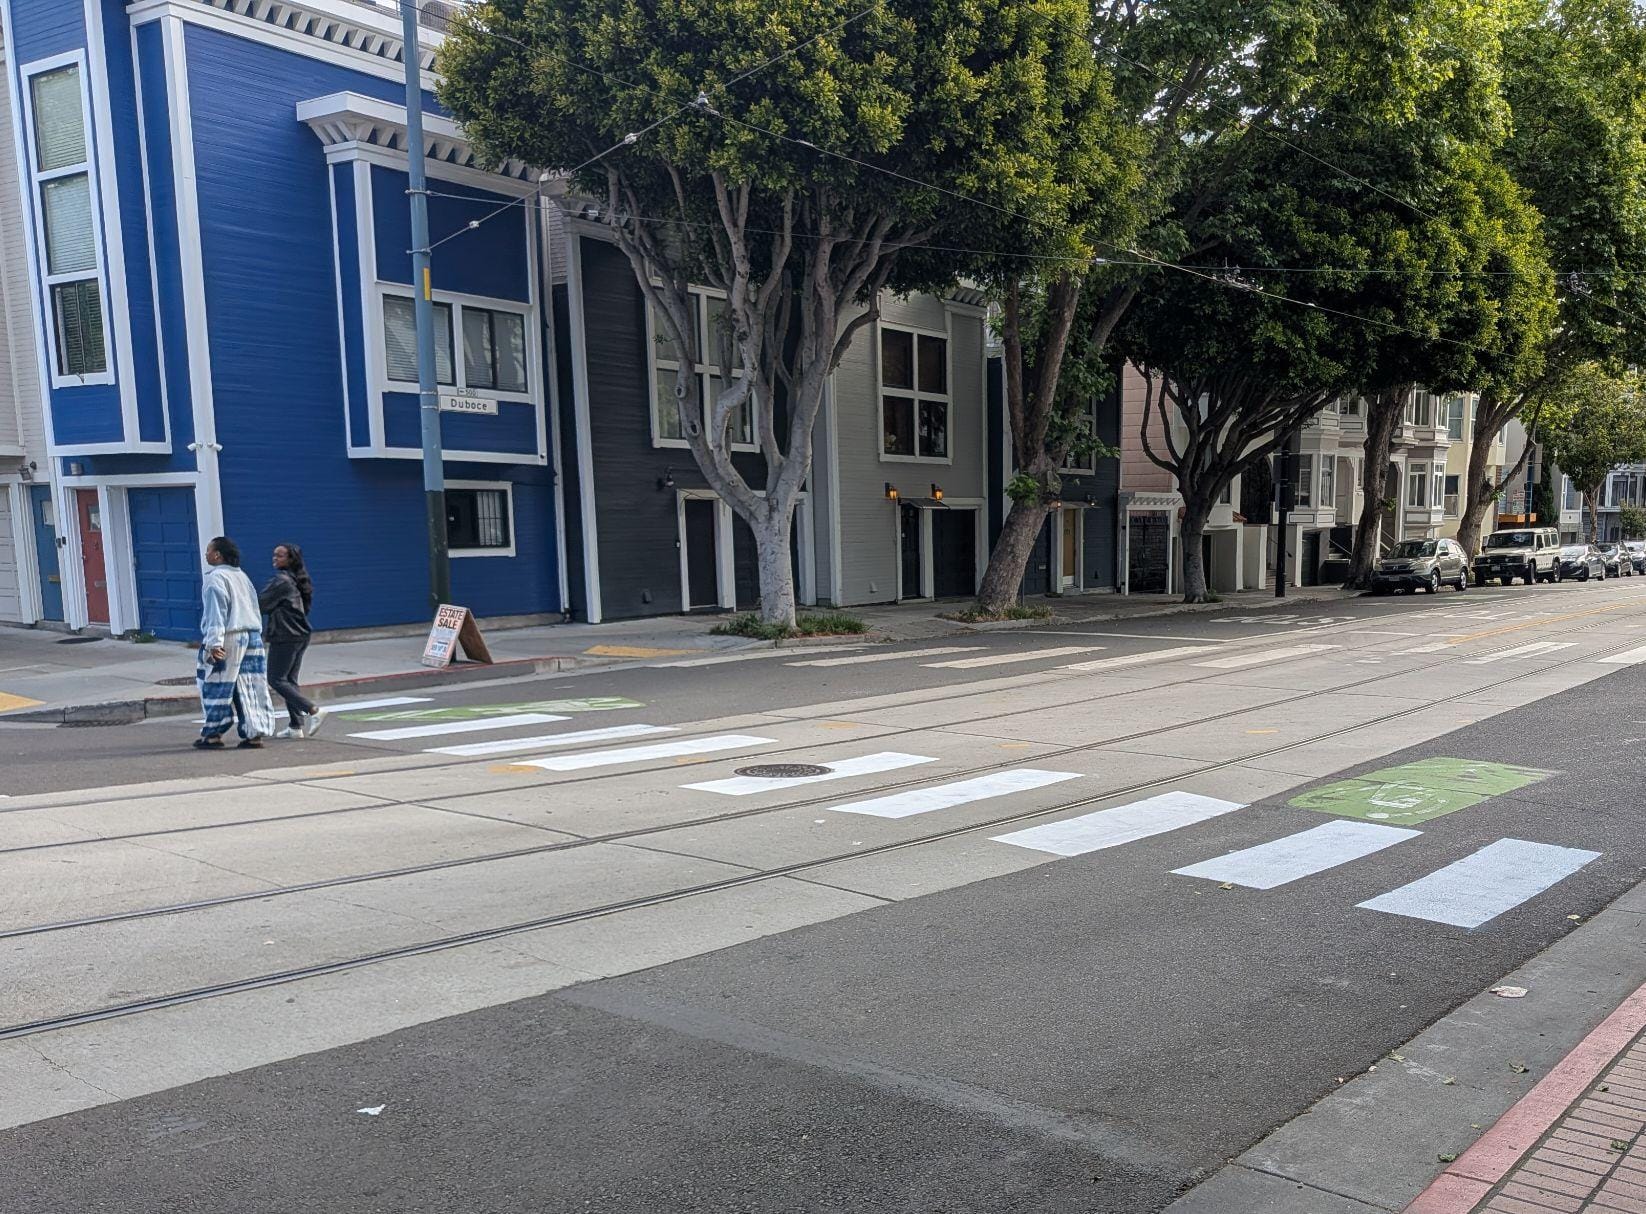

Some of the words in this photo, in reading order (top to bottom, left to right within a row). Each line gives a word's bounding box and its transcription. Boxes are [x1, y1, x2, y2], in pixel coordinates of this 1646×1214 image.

[451, 398, 487, 411] Duboce
[439, 607, 463, 620] ESTATE
[438, 618, 458, 630] SALE
